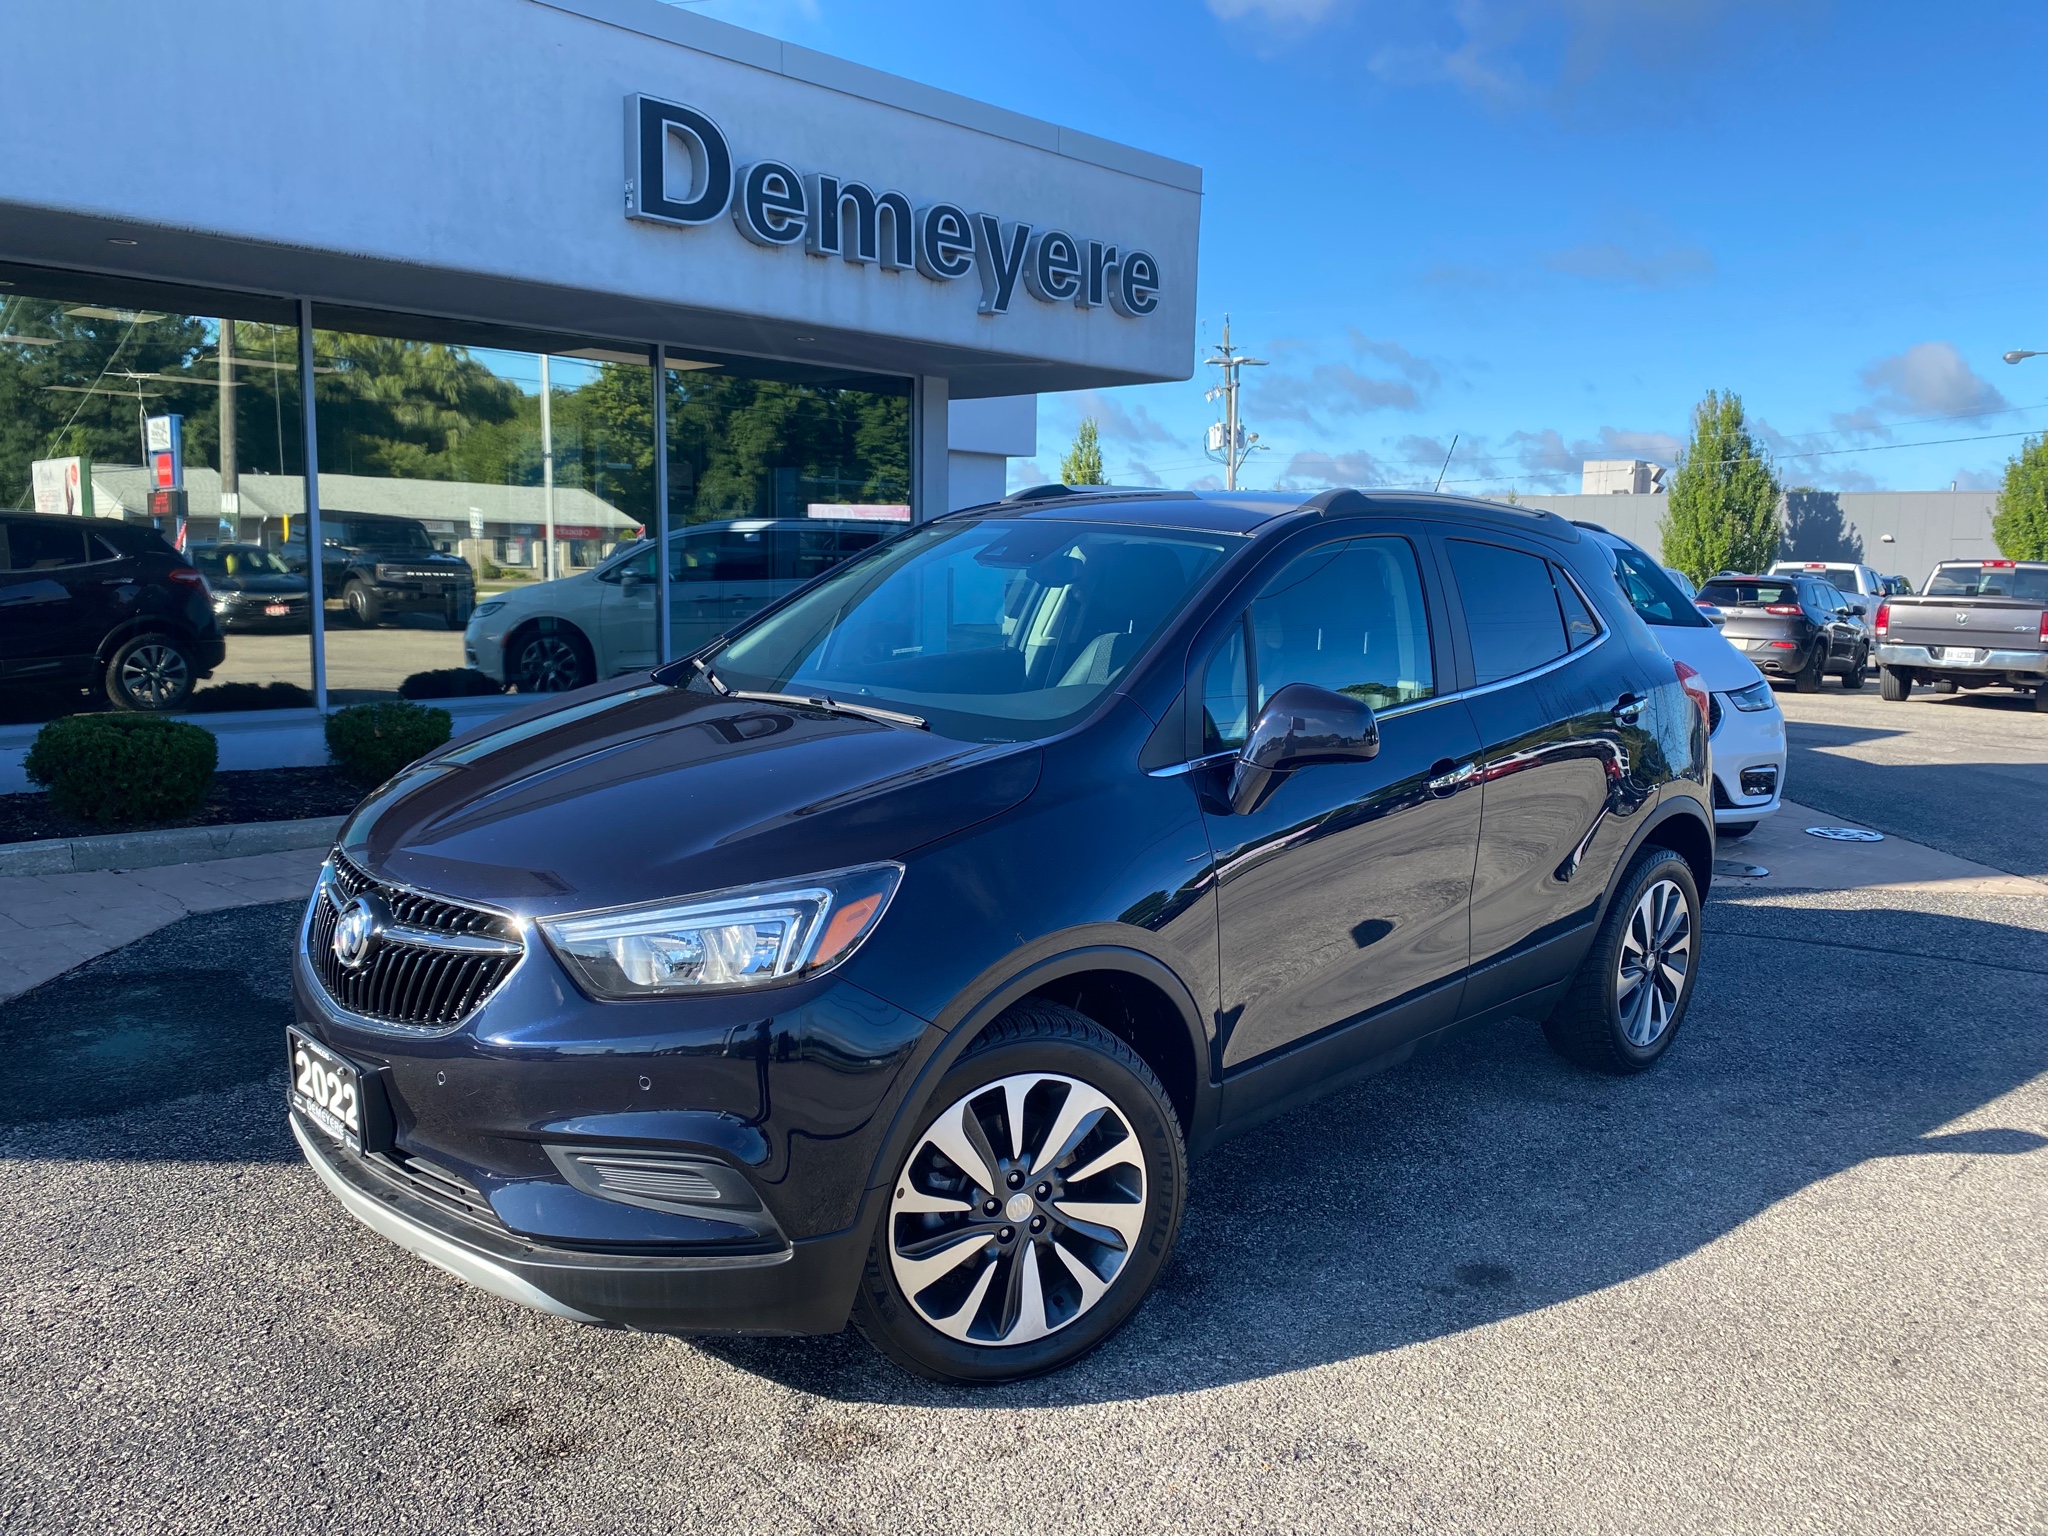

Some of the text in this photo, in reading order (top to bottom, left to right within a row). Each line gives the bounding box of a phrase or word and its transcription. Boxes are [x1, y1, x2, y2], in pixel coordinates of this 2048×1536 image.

[626, 92, 1161, 317] Demeyere
[295, 1050, 358, 1131] 2022
[306, 1097, 346, 1135] DEMEYERE
